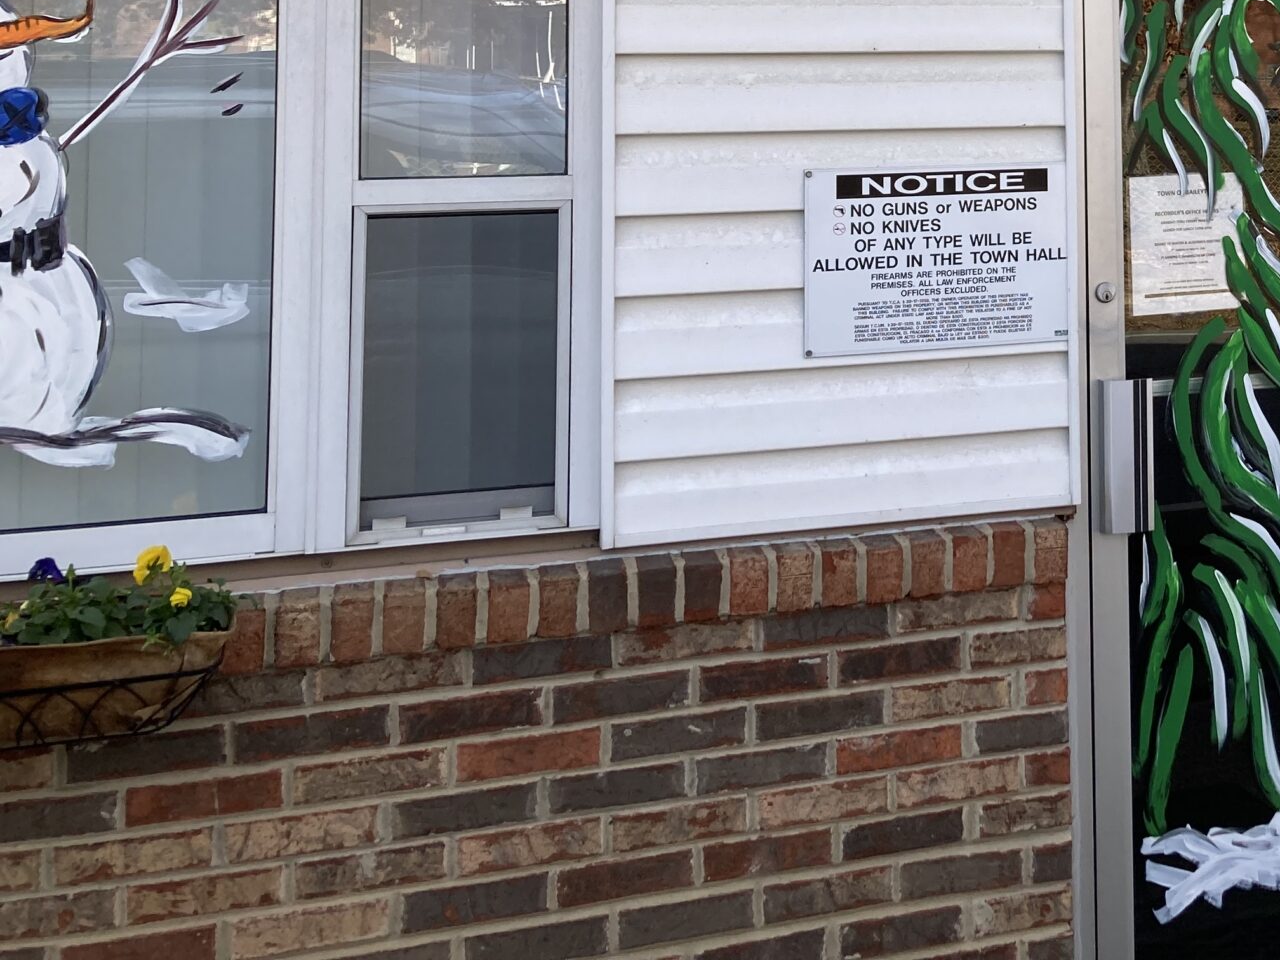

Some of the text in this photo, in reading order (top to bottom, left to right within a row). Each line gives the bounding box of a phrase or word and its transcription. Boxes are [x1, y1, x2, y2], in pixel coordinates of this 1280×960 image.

[861, 172, 1024, 195] NOTICE
[850, 197, 1037, 217] NO GUNS or WEAPONS
[850, 218, 941, 235] NO KNIVES
[854, 231, 1032, 253] OF ANY TYPE WILL BE
[812, 247, 1067, 272] ALLOWED IN THE TOWN HALL
[871, 271, 913, 281] FIREARMS
[916, 270, 933, 279] ARE
[936, 268, 983, 277] PROHIBITED
[1001, 266, 1016, 274] THE
[918, 279, 933, 287] ALL
[936, 278, 953, 286] LAW
[956, 275, 1016, 285] ENFORCEMENT
[900, 287, 941, 297] OFFICERS
